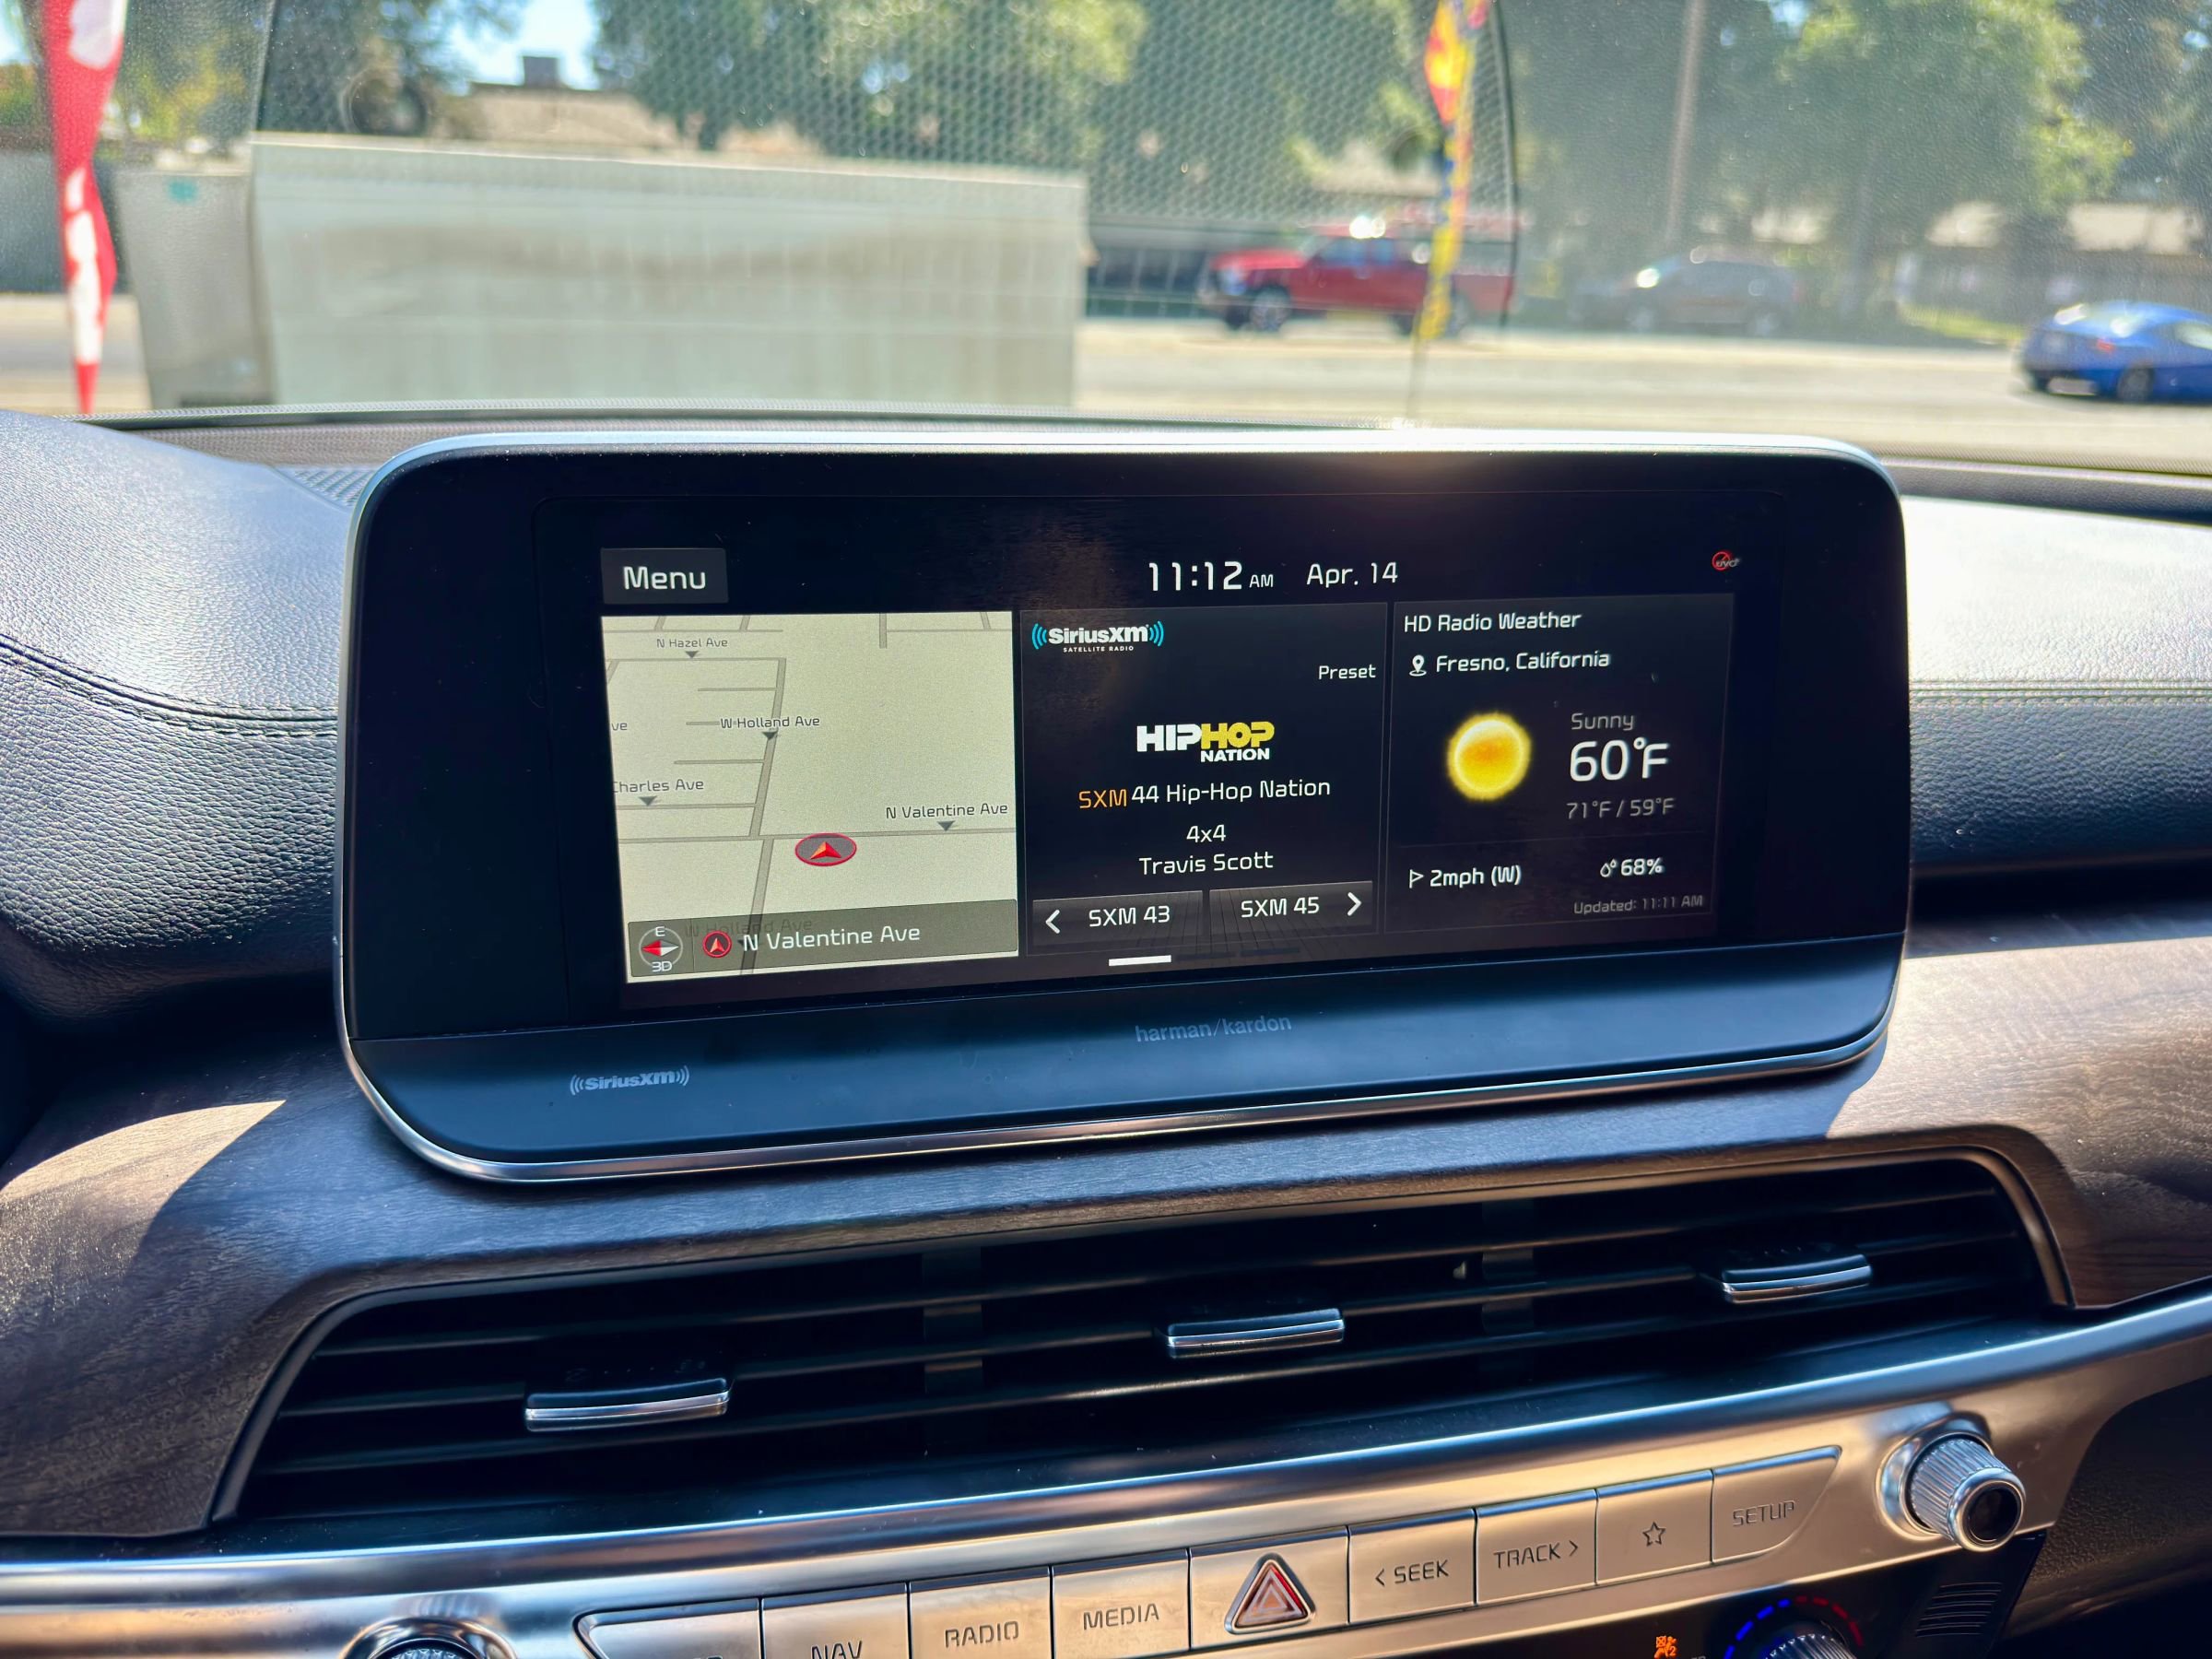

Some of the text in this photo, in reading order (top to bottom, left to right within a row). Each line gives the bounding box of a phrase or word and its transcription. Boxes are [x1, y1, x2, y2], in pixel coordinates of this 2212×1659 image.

[622, 565, 707, 590] Menu
[1148, 560, 1274, 592] 11:12 AM
[1306, 561, 1398, 588] Apr. 14
[1404, 611, 1583, 633] HD Radio Weather
[656, 637, 728, 649] N Hazel Ave
[1318, 664, 1377, 680] Preset
[1436, 650, 1611, 674] Fresno, California
[720, 714, 820, 729] W Holland Ave
[1571, 712, 1635, 733] Sunny
[1200, 747, 1270, 762] NATION
[1569, 736, 1670, 782] 60°F
[676, 779, 704, 791] Ave
[1078, 779, 1331, 809] SXM 44 Hip-Hop Nation
[885, 802, 1009, 820] N Valentine Ave
[1567, 799, 1613, 819] 71°F
[1630, 796, 1677, 817] 59°F
[1185, 824, 1227, 843] 4x4
[1139, 851, 1274, 876] Travis Scott
[1620, 857, 1665, 877] 68%
[1430, 864, 1522, 888] 2mph (W)
[1241, 896, 1320, 918] SXM 45
[1573, 894, 1703, 915] Updated: 11:11 AM
[1088, 905, 1171, 927] SXM 43
[654, 926, 665, 937] E
[742, 924, 921, 951] N Valentine Ave
[651, 960, 673, 972] 3D
[1135, 1015, 1293, 1042] harman/kardon
[1731, 1500, 1796, 1527] SETUP
[1493, 1542, 1561, 1570] TRACK
[1393, 1559, 1450, 1585] SEEK
[1082, 1602, 1160, 1631] MEDIA
[943, 1619, 1020, 1649] RADIO
[810, 1640, 864, 1659] NAV
